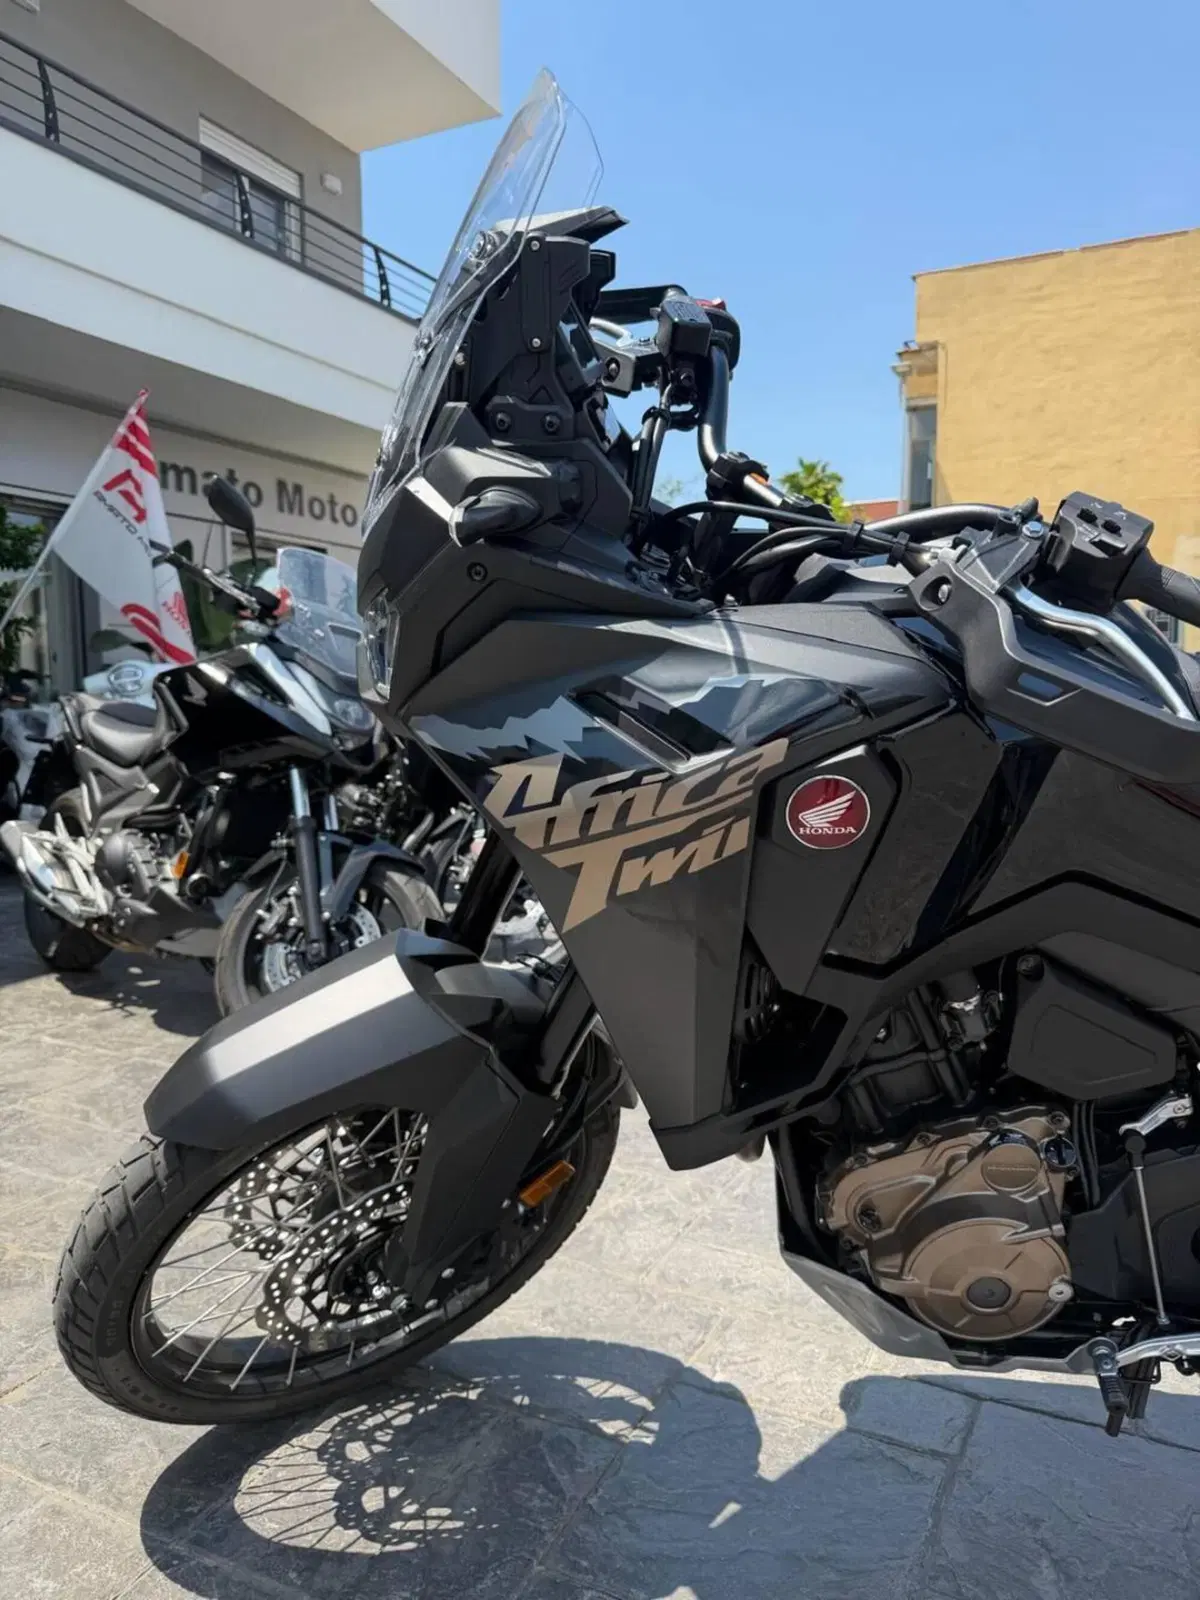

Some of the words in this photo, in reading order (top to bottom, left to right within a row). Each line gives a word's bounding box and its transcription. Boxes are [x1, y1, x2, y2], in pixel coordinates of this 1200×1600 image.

[276, 478, 358, 527] Moto
[483, 738, 789, 850] Africa
[799, 826, 857, 836] HONDA
